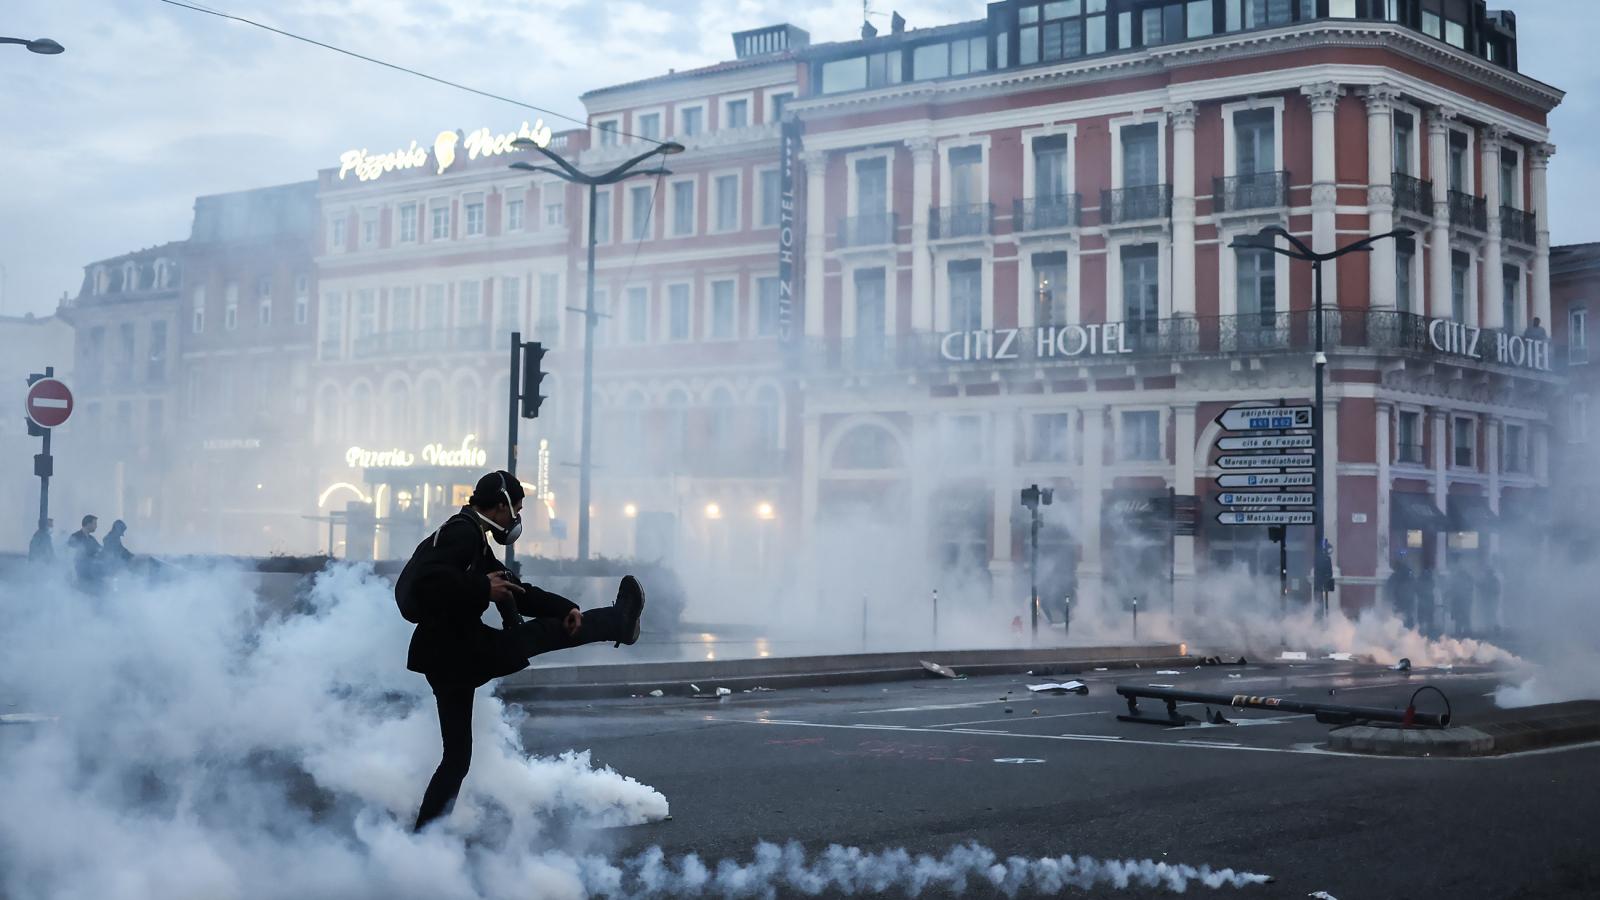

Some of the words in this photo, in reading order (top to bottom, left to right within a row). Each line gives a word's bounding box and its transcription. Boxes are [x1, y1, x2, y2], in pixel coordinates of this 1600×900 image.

[781, 189, 793, 263] HOTEL
[941, 328, 1019, 360] CITIZ
[1037, 322, 1133, 357] HOTEL
[1429, 319, 1482, 358] CITIZ
[1496, 332, 1553, 371] HOTEL
[1241, 410, 1293, 418] périphérique
[346, 446, 415, 467] Pizzeria
[422, 434, 487, 467] Vecchio
[1242, 439, 1258, 447] cité
